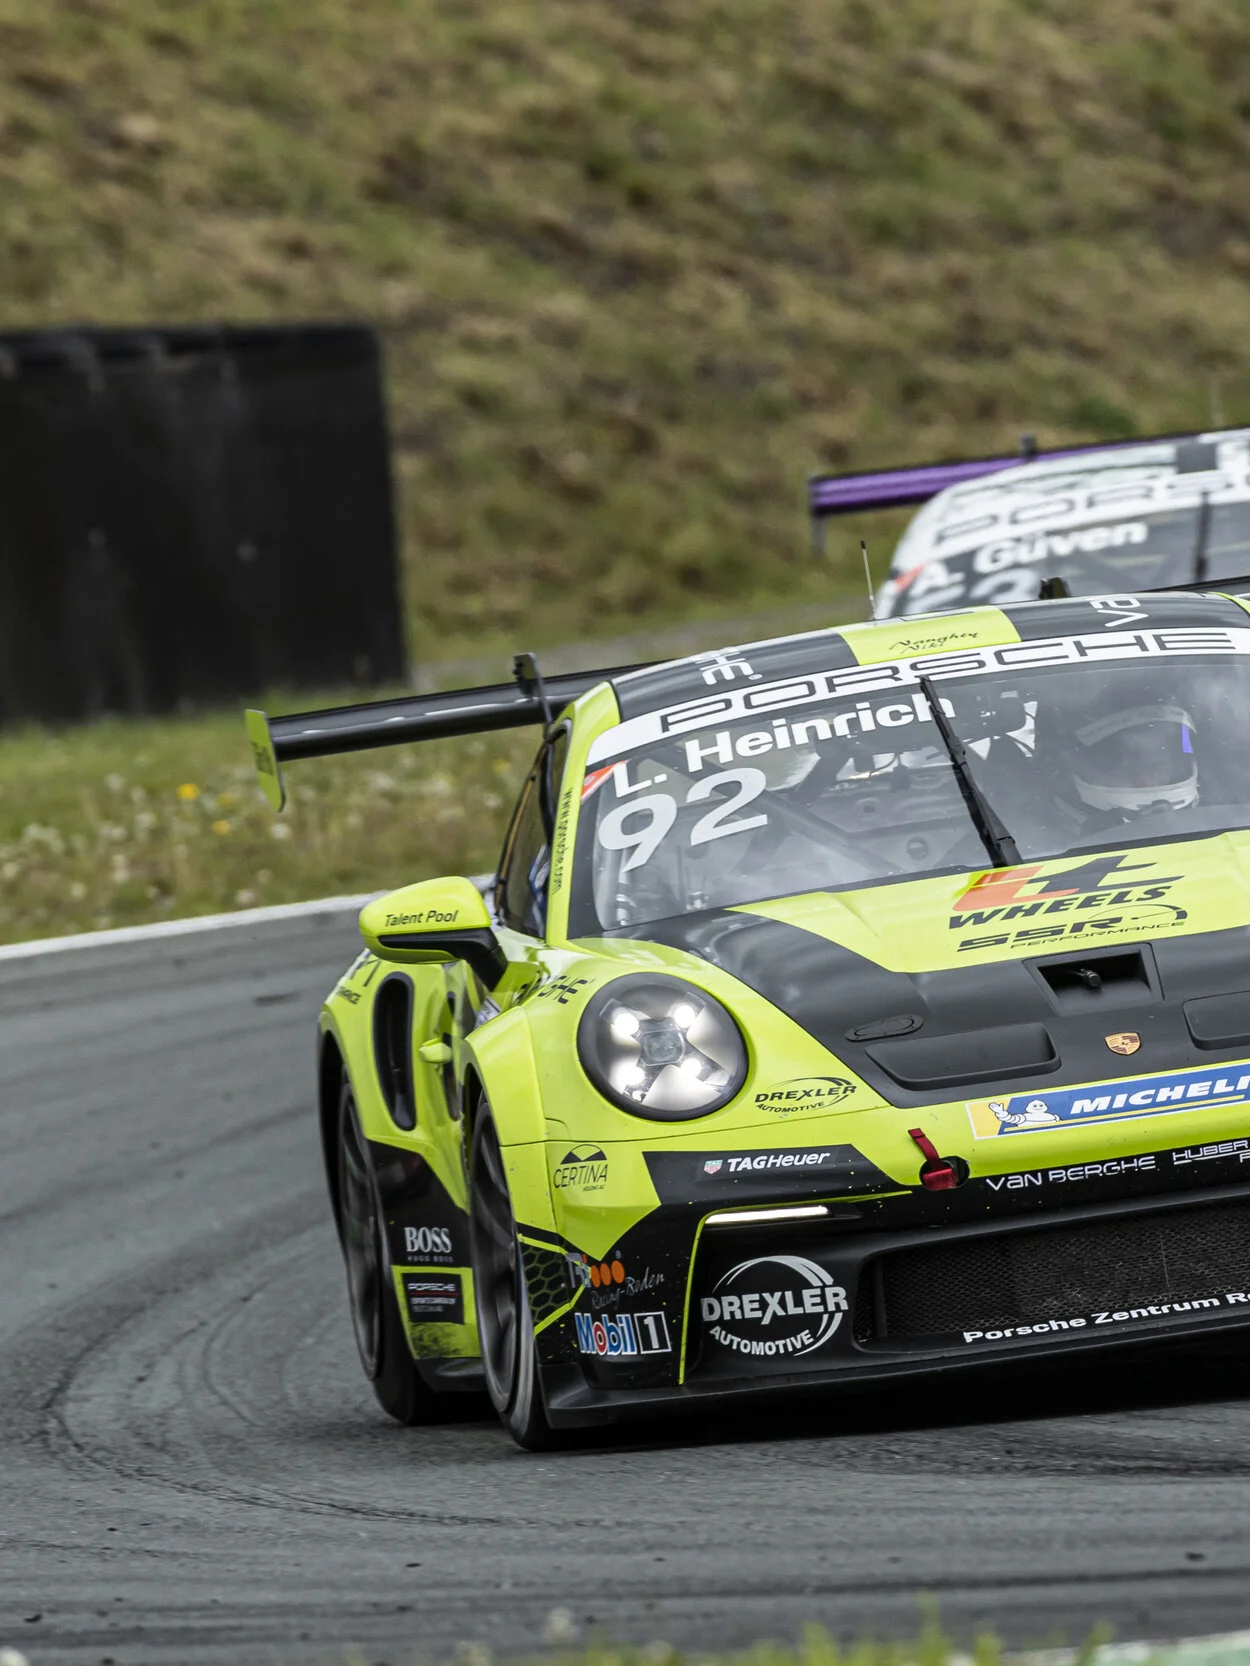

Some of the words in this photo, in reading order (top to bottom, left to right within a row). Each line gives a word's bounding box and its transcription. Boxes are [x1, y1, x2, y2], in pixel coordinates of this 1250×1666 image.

[973, 522, 1147, 574] Güven
[660, 633, 1236, 734] PORSCHE
[613, 760, 667, 798] L.
[685, 692, 956, 773] Heinrich
[598, 767, 768, 872] 92
[385, 912, 423, 927] Talent
[426, 910, 459, 923] Pool
[948, 886, 1172, 929] WHEELS
[957, 917, 1123, 952] SSR
[1010, 921, 1185, 949] PERFORMANCE
[755, 1086, 857, 1103] DREXLER
[756, 1101, 825, 1113] AUTOMOTIVE
[1172, 1139, 1249, 1162] HUBER
[553, 1164, 608, 1188] CERTINA
[1049, 1156, 1156, 1183] BERGHE
[404, 1227, 452, 1254] BOSS
[700, 1286, 849, 1325] DREXLER
[963, 1318, 1087, 1343] Porsche
[1091, 1296, 1220, 1324] Zentrum
[574, 1312, 637, 1355] Mobil
[643, 1316, 660, 1349] 1
[709, 1325, 814, 1355] AUTOMOTIVE
